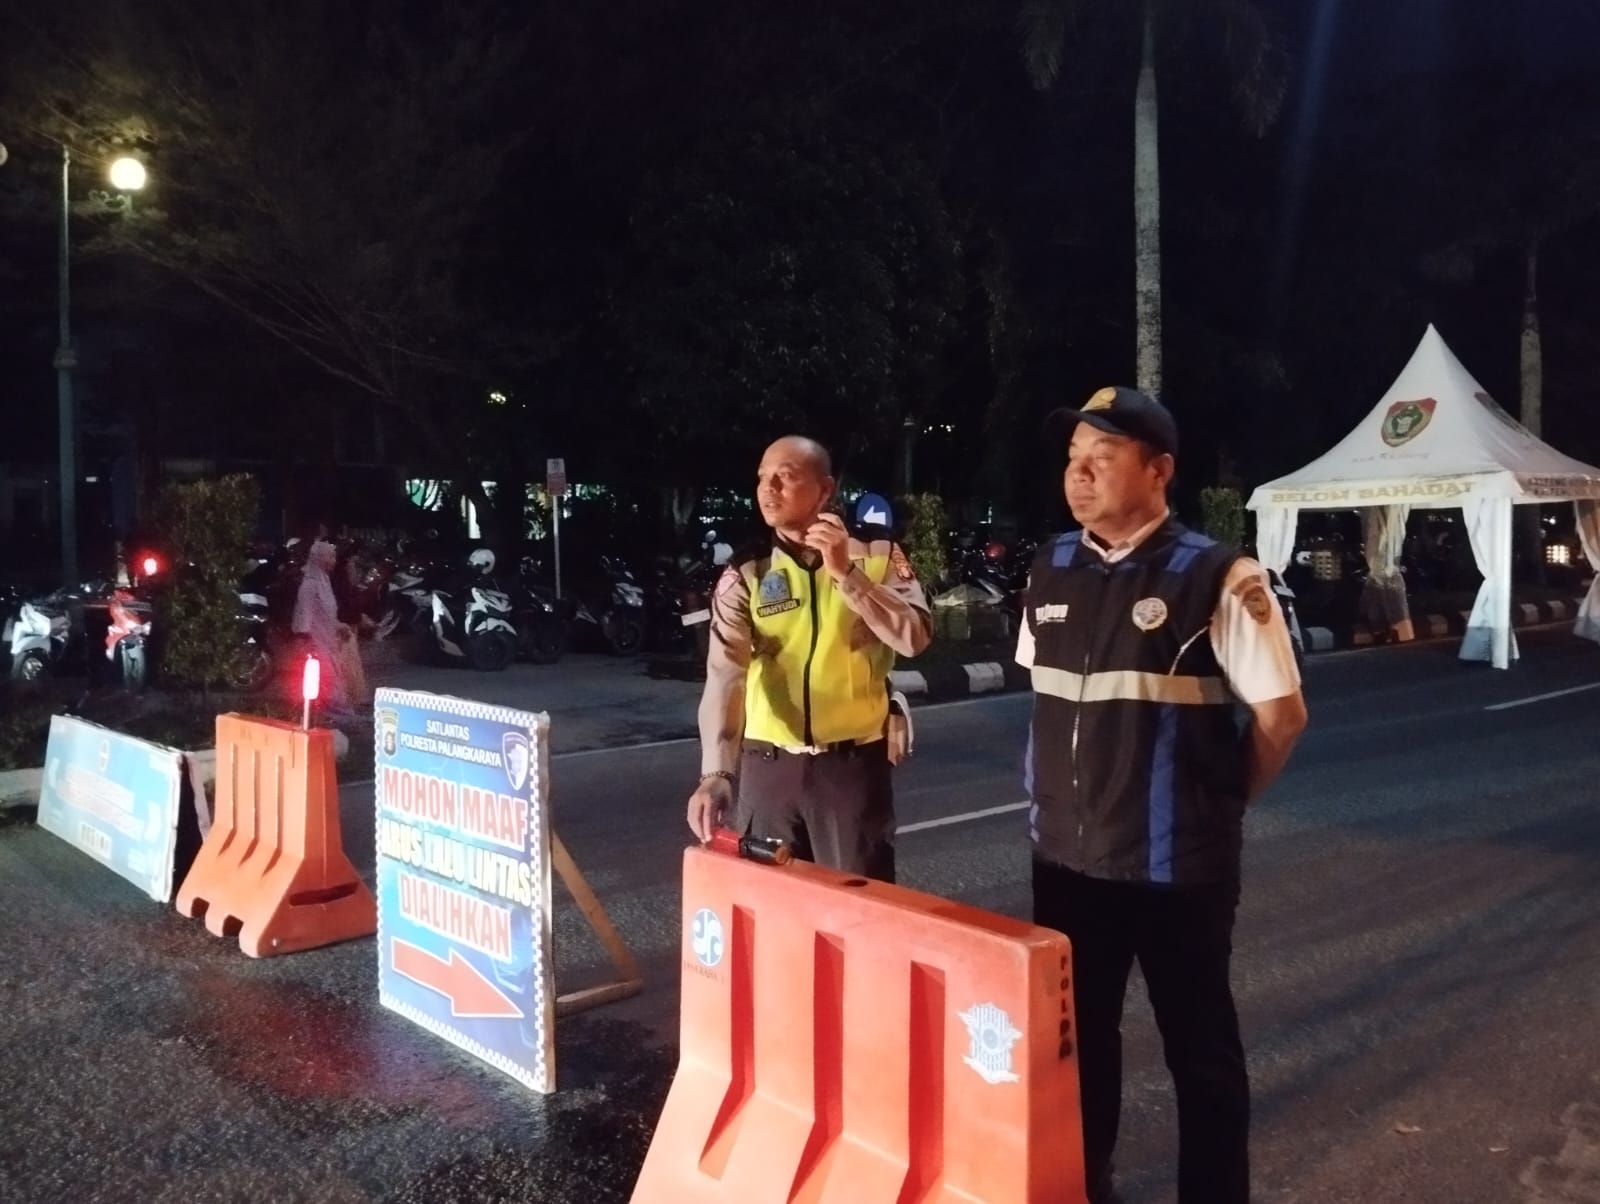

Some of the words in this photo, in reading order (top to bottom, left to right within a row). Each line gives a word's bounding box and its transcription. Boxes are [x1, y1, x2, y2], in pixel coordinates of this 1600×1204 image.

[1271, 489, 1350, 503] BELOM
[1358, 482, 1477, 499] BAHADAT
[758, 599, 798, 617] WAHYUDI
[426, 719, 470, 741] SATLANTAS
[400, 732, 437, 753] POLRESTA
[438, 739, 502, 767] PALANGKARAYA
[382, 765, 456, 827] MOHON
[462, 784, 528, 851] MAAF
[381, 818, 422, 867] ARUS
[423, 830, 465, 883] LALU
[467, 844, 532, 907] LINTAS
[400, 873, 511, 961] DIALIHKAN
